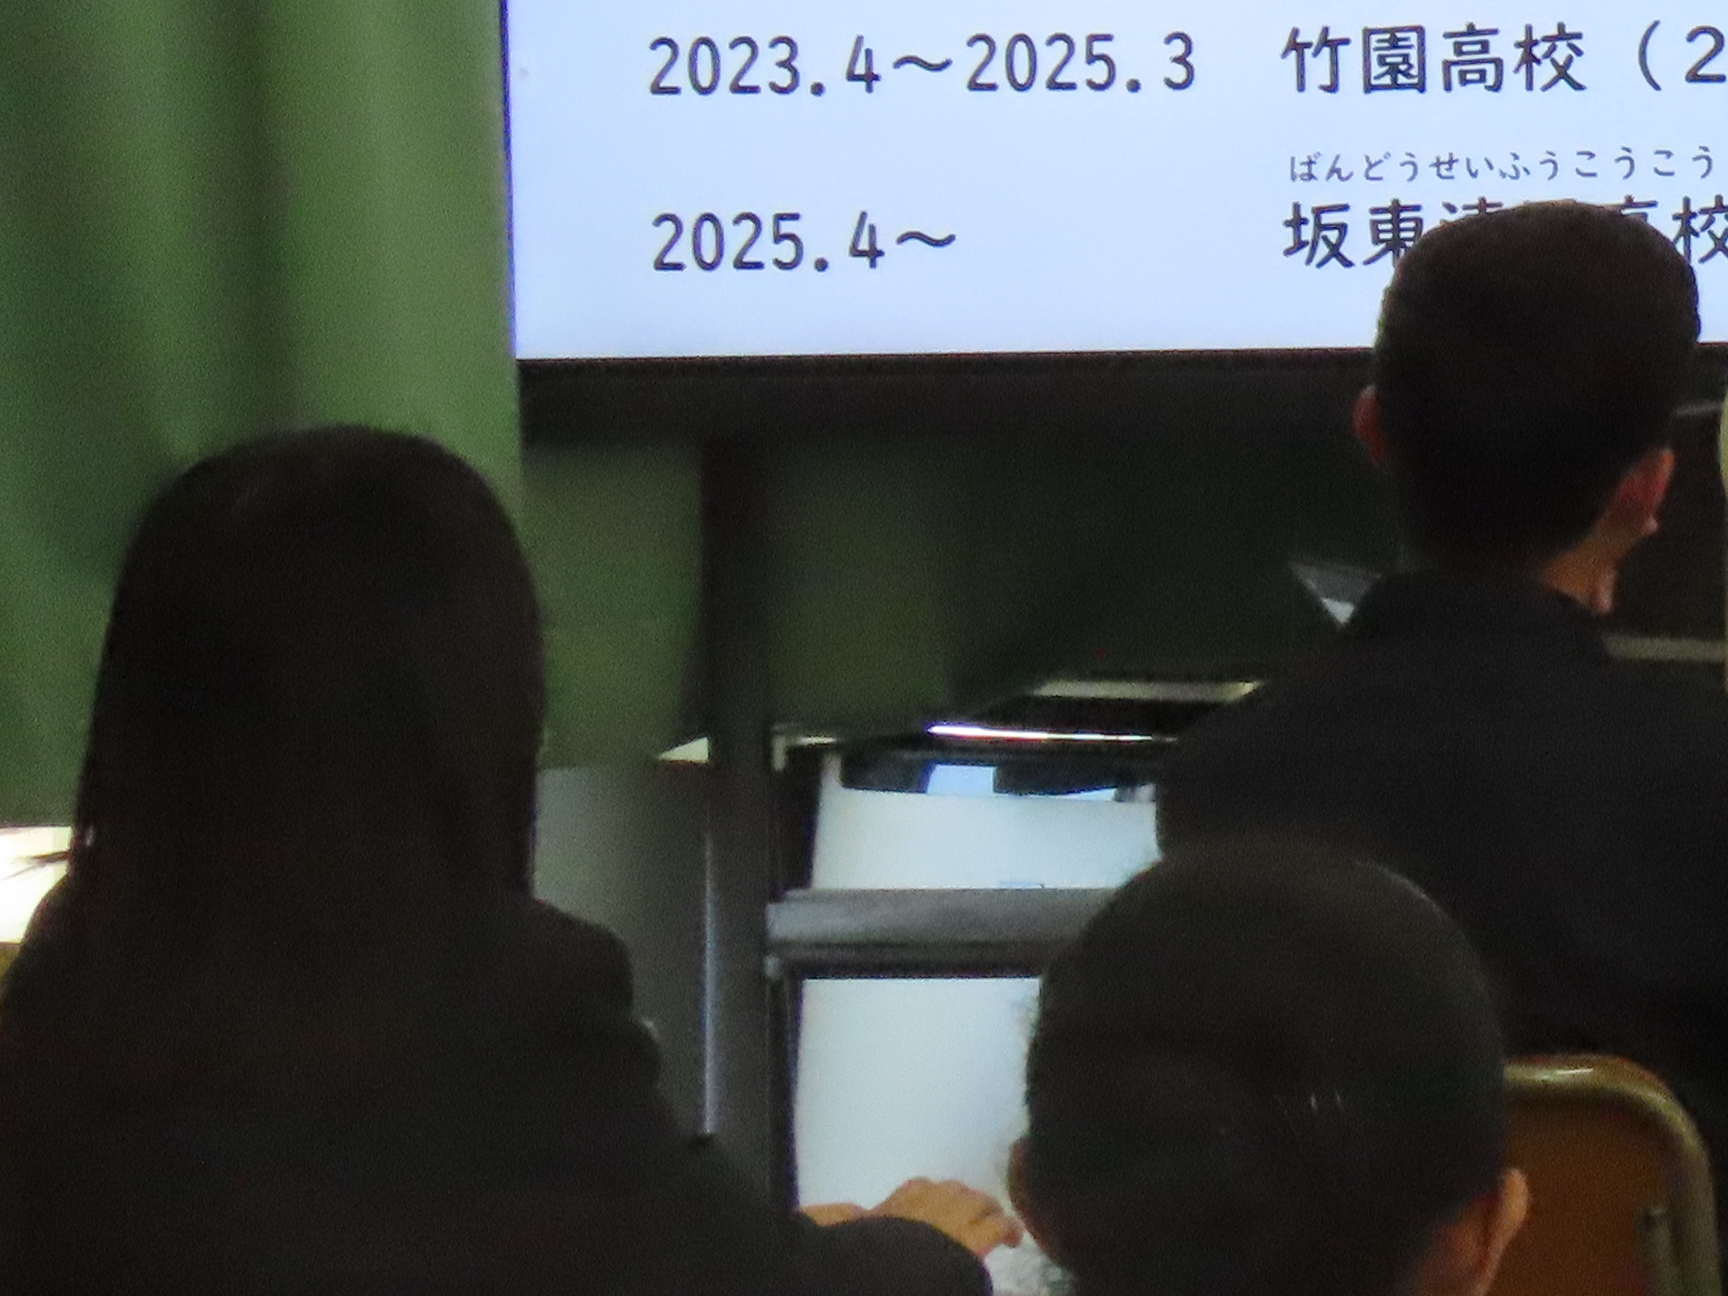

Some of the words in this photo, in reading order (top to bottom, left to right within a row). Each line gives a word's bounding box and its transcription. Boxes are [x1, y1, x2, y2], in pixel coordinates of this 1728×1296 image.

[648, 31, 1196, 98] 2023.4～2025.3
[1289, 145, 1714, 182] ばんどうせいふうこうこう
[652, 210, 957, 273] 2025.4～
